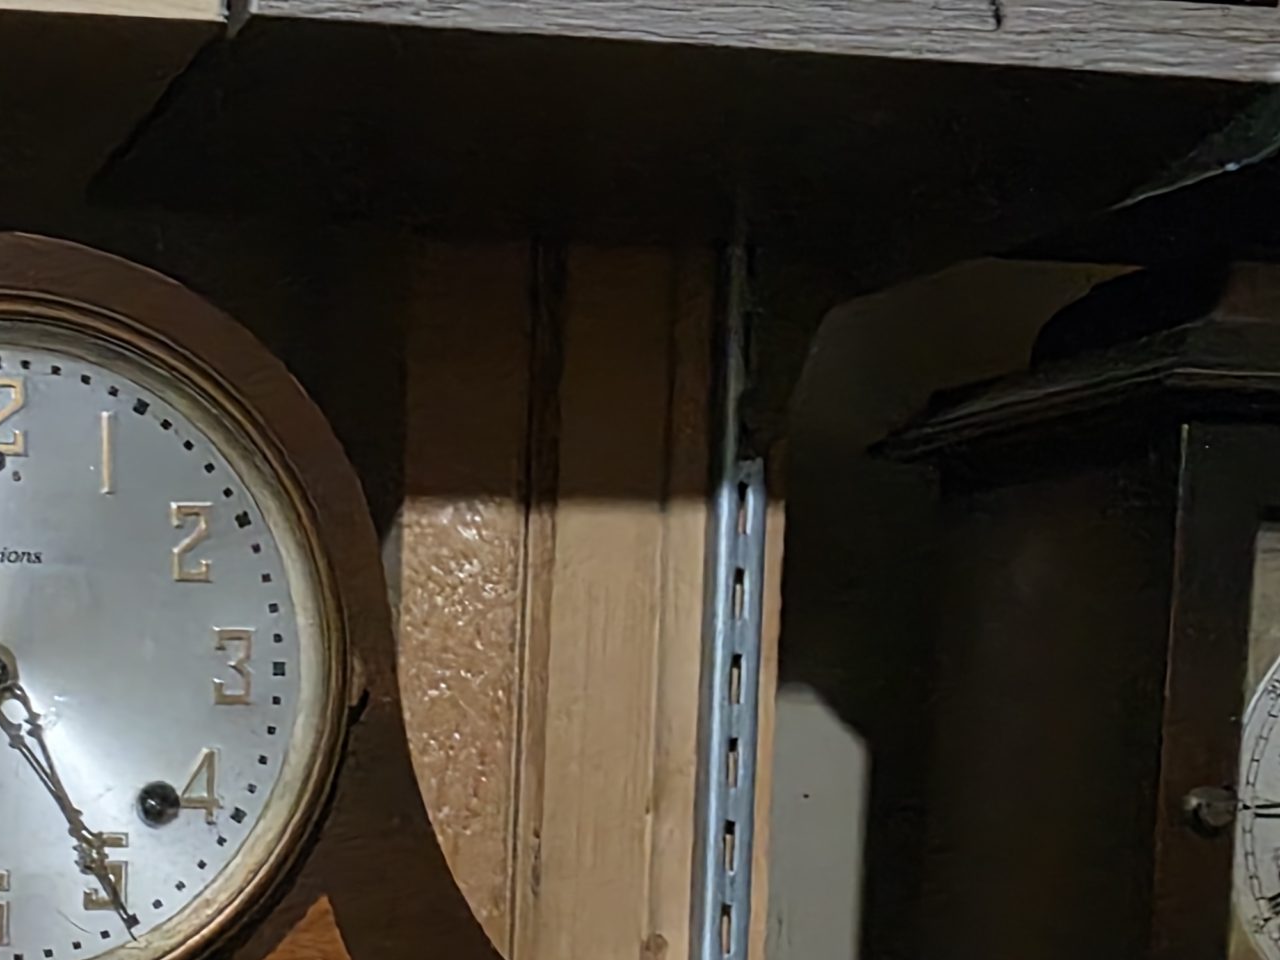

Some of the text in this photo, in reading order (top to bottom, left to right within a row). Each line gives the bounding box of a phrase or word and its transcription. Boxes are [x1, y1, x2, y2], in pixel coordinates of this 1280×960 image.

[100, 410, 116, 495] 1
[170, 501, 214, 583] 2
[213, 626, 257, 706] 3
[178, 747, 223, 825] 4
